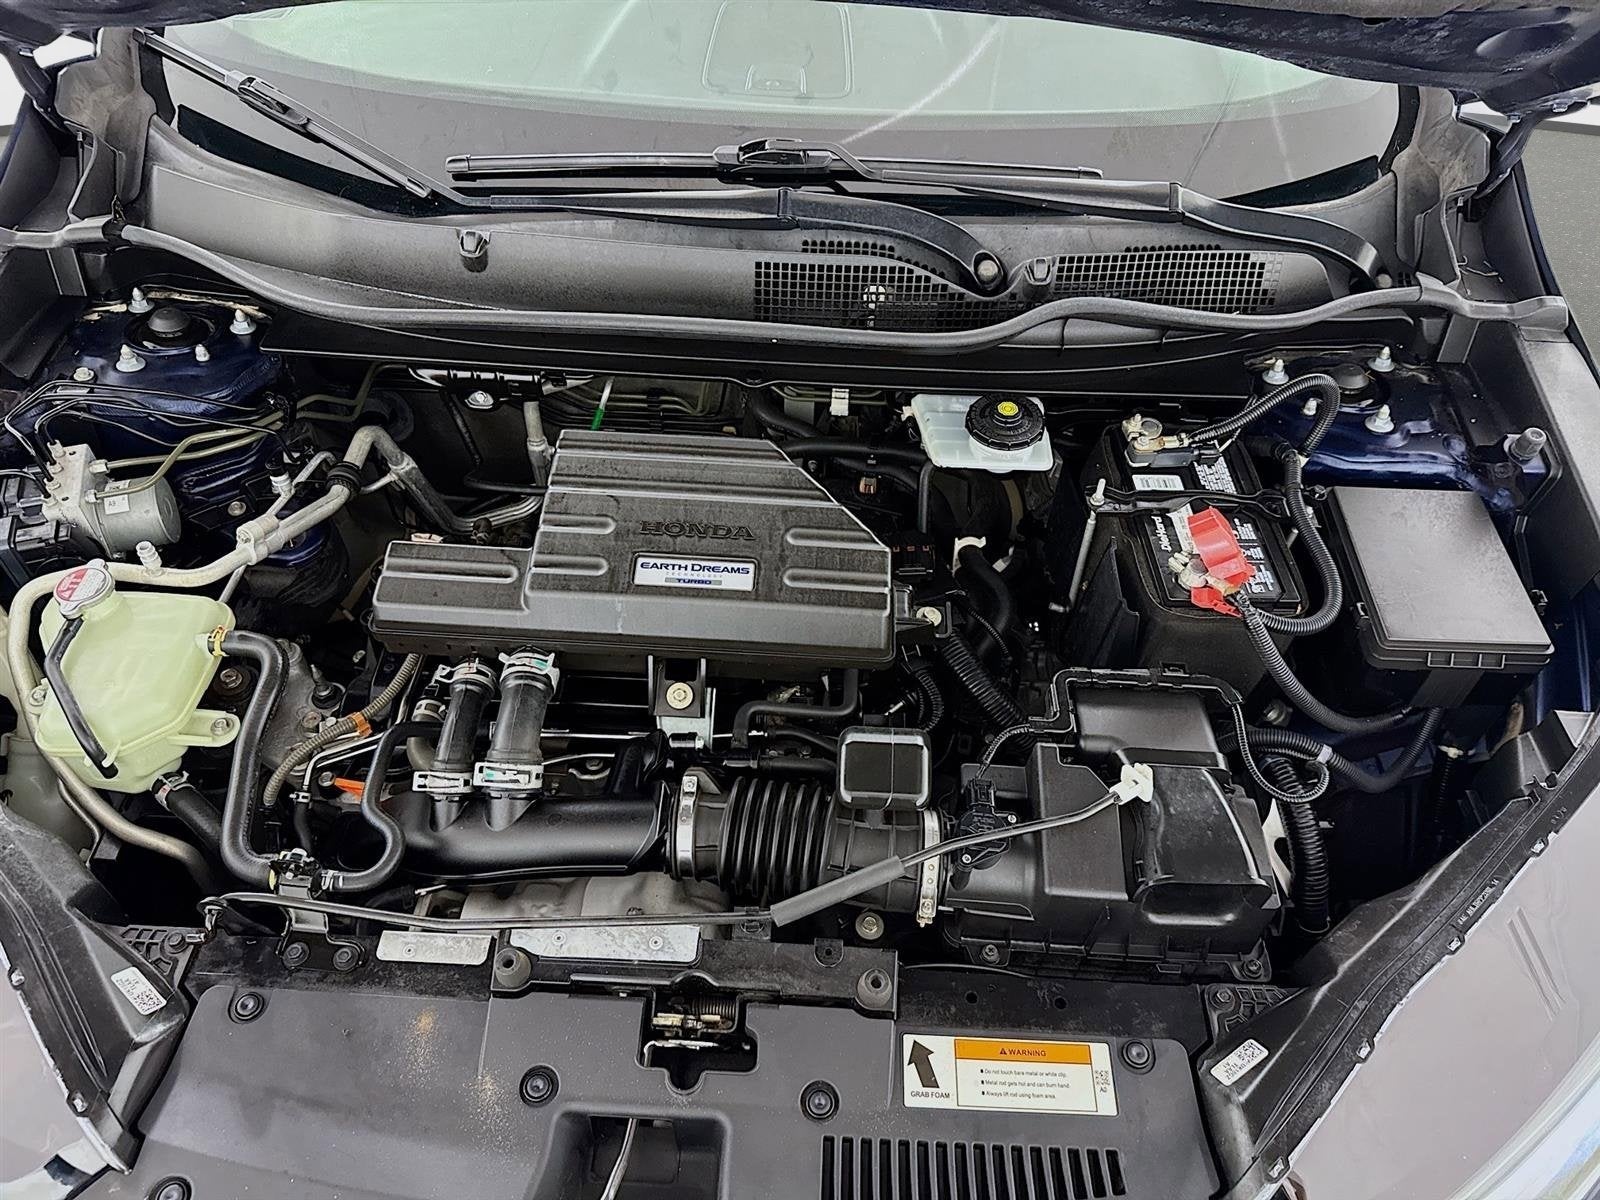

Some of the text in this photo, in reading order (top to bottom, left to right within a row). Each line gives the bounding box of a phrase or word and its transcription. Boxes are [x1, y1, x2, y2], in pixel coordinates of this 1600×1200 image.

[639, 520, 756, 540] HONDA
[640, 561, 688, 572] EARTH
[1008, 1048, 1047, 1058] WARNING
[910, 1091, 951, 1100] GRAB FOAM
